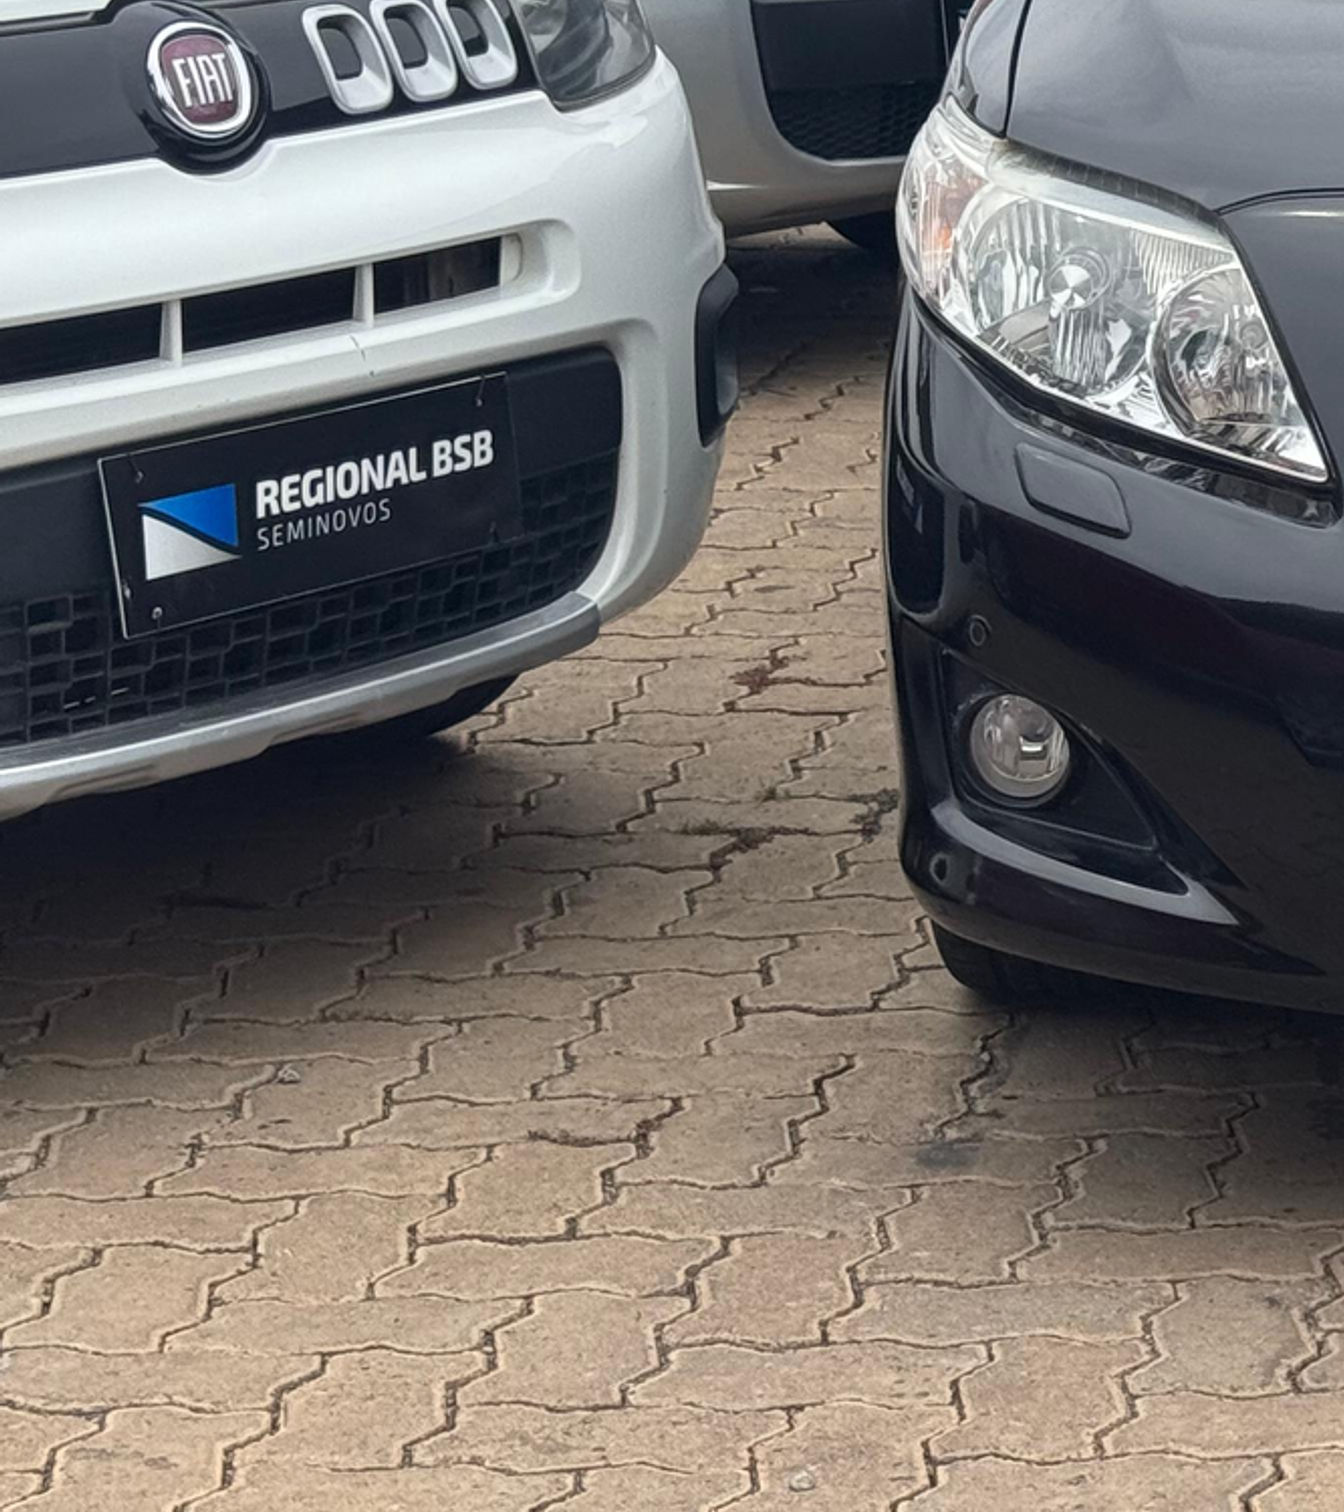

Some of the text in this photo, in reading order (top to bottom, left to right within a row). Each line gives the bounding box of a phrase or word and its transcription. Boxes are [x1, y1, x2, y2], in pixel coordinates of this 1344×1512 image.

[171, 52, 233, 108] FIAT
[256, 429, 494, 519] REGIONAL BSB
[257, 498, 391, 551] SEMINOVOS
